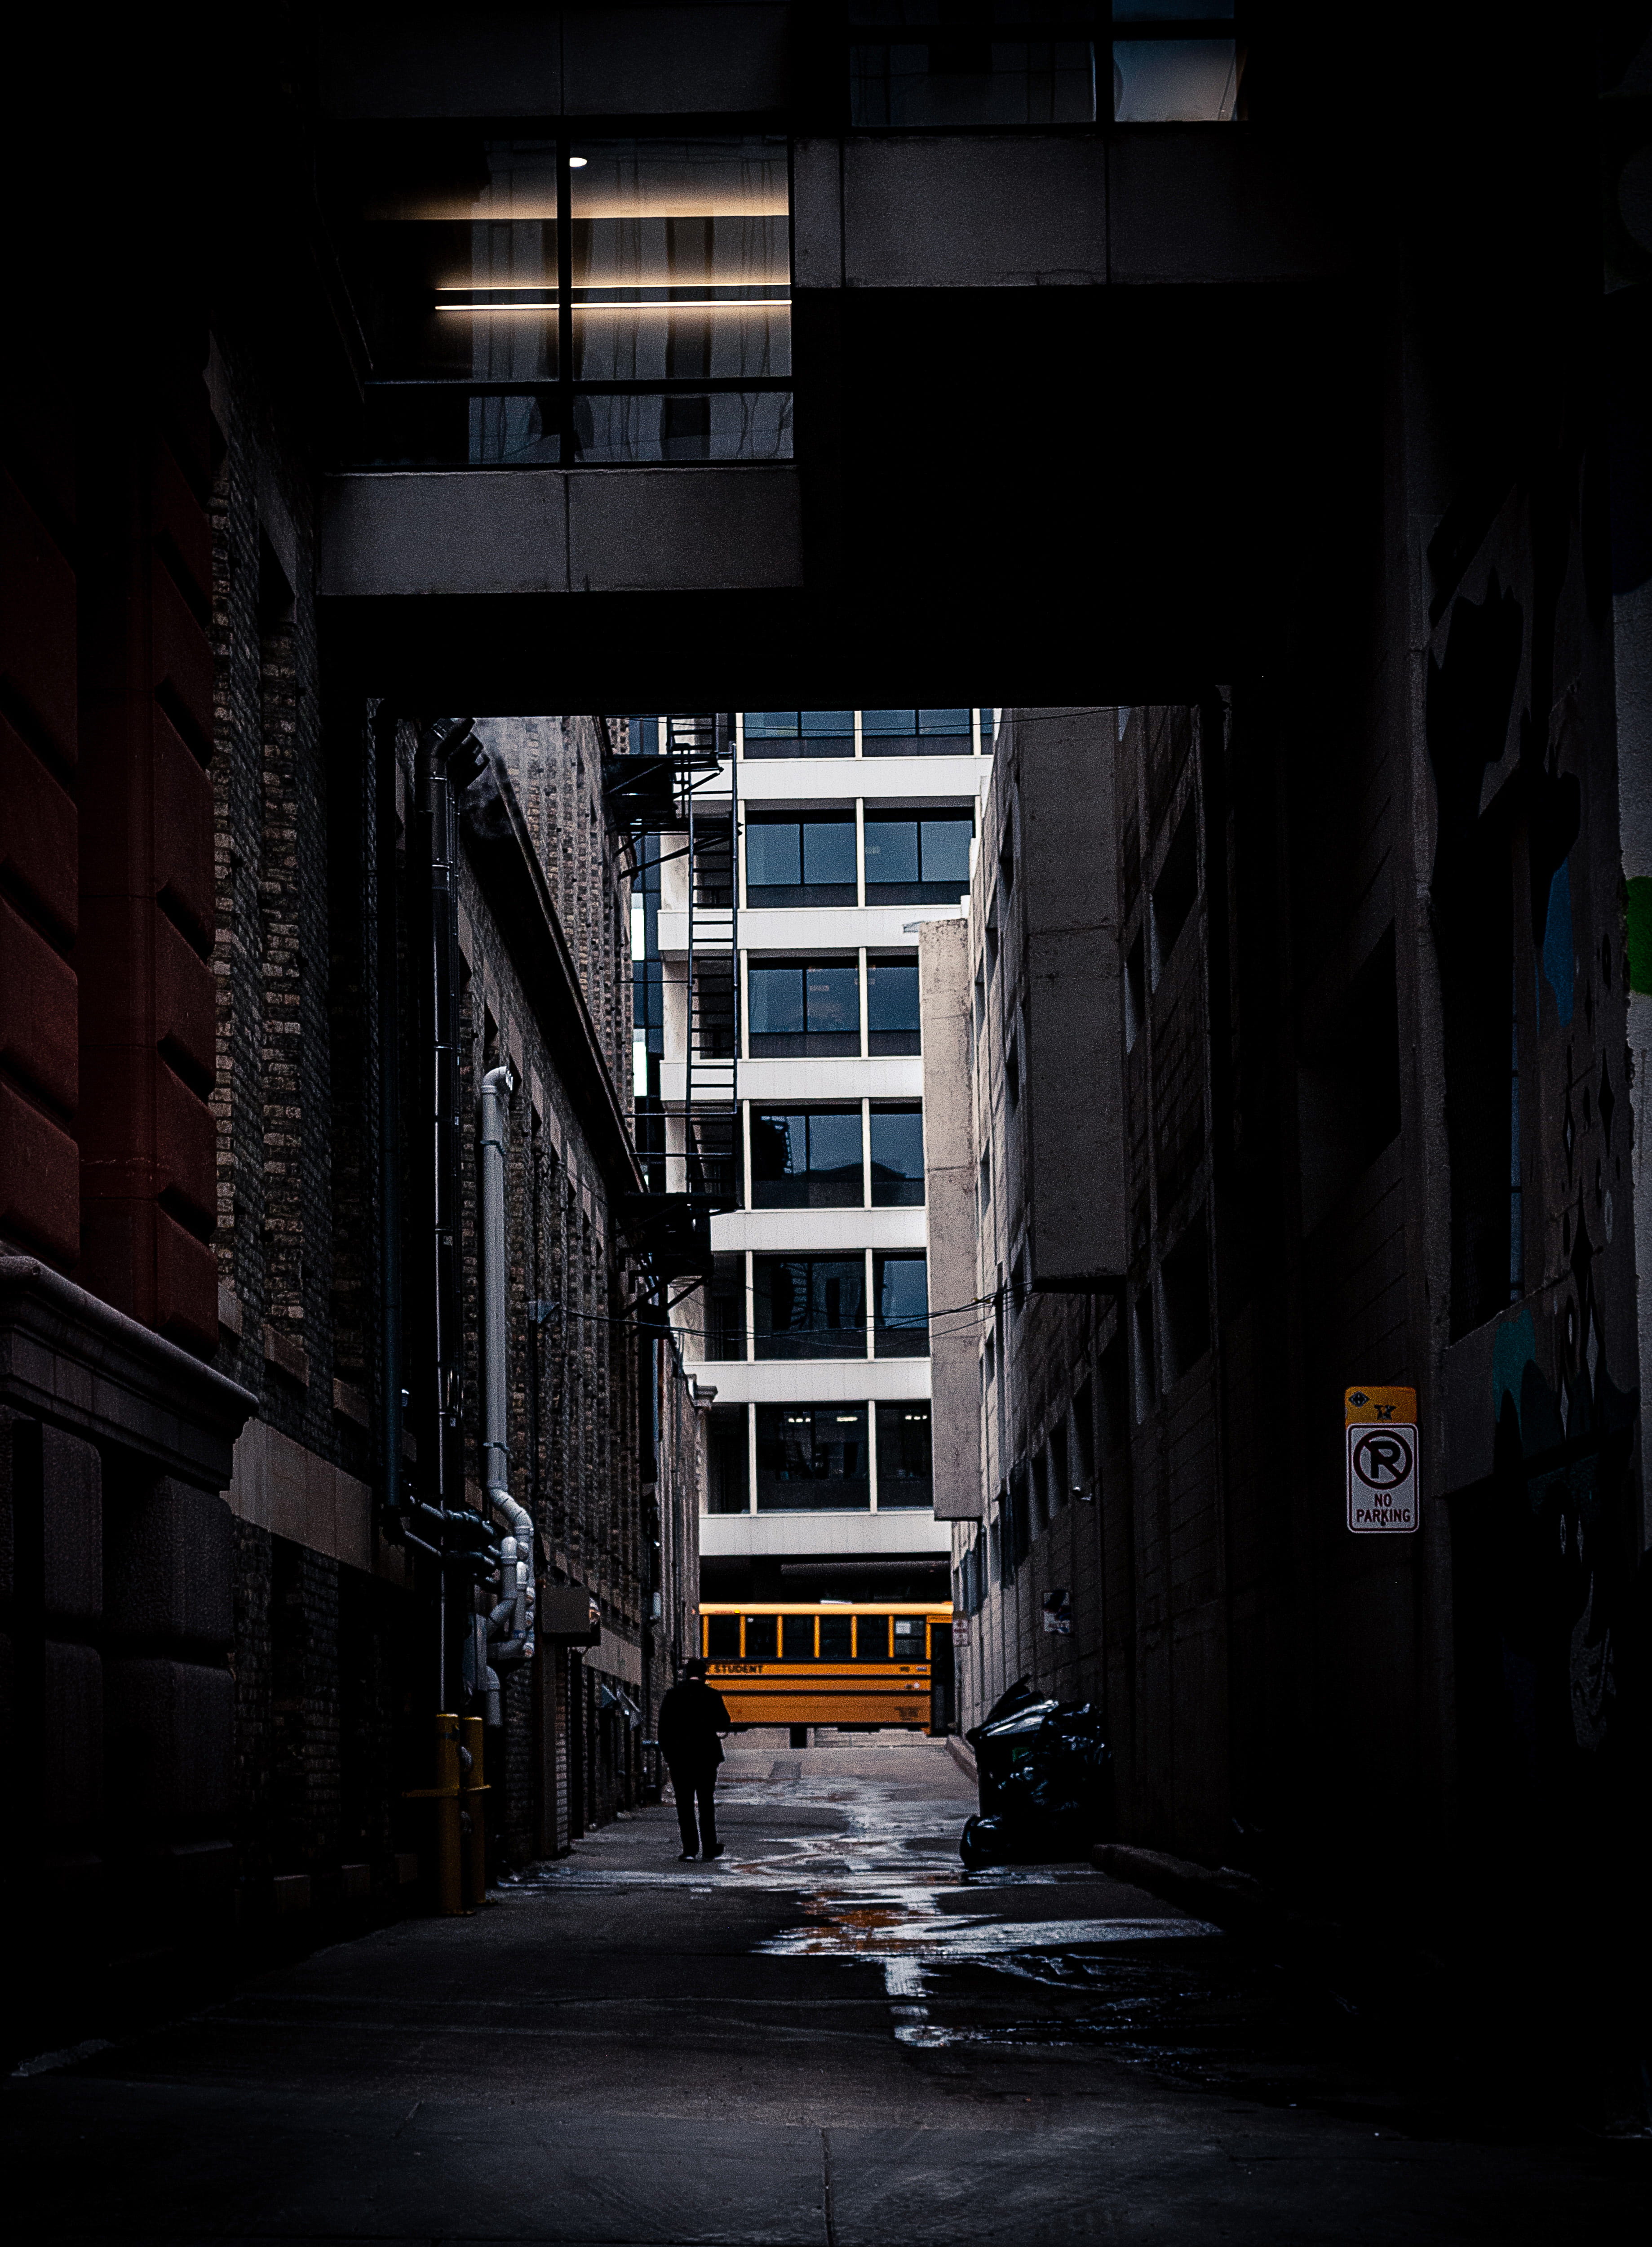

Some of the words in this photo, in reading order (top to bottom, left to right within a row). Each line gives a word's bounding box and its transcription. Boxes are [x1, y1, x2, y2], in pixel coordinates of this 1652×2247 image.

[1374, 1494, 1392, 1506] NO
[1356, 1510, 1411, 1523] PARKING
[715, 1665, 763, 1673] STUDENT
